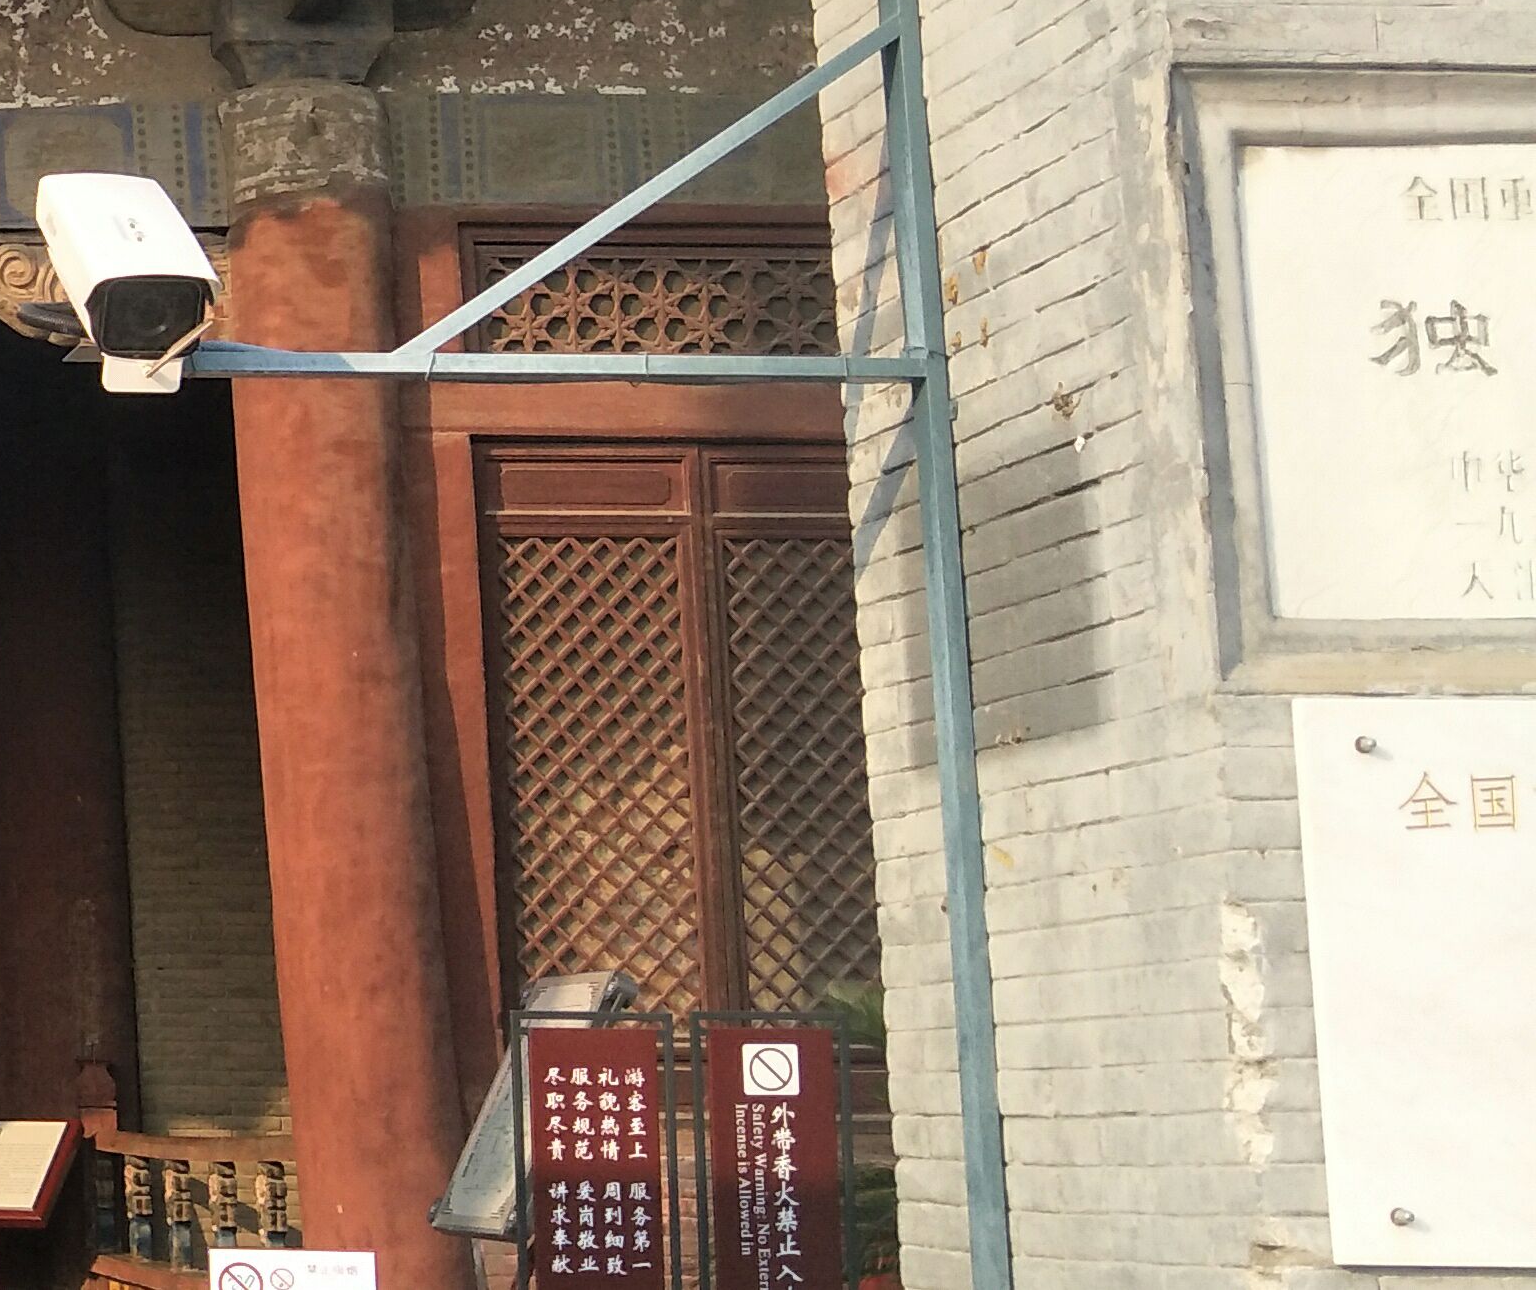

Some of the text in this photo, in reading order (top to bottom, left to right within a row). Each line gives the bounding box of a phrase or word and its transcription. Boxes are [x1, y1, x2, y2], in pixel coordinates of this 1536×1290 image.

[1369, 298, 1498, 377] 独
[1399, 770, 1536, 833] 全国
[543, 1067, 574, 1275] 尽职尽责 讲求奉献
[569, 1067, 600, 1274] 服务规范 爱岗敬业
[597, 1067, 628, 1276] 礼貌热情 周到细致
[624, 1067, 653, 1270] 游客至上 服务第一
[735, 1103, 754, 1257] Incense is Allowed in
[751, 1103, 767, 1150] Safety
[770, 1101, 804, 1290] 外带香火禁止入
[757, 1223, 771, 1245] No
[758, 1247, 772, 1290] Exter
